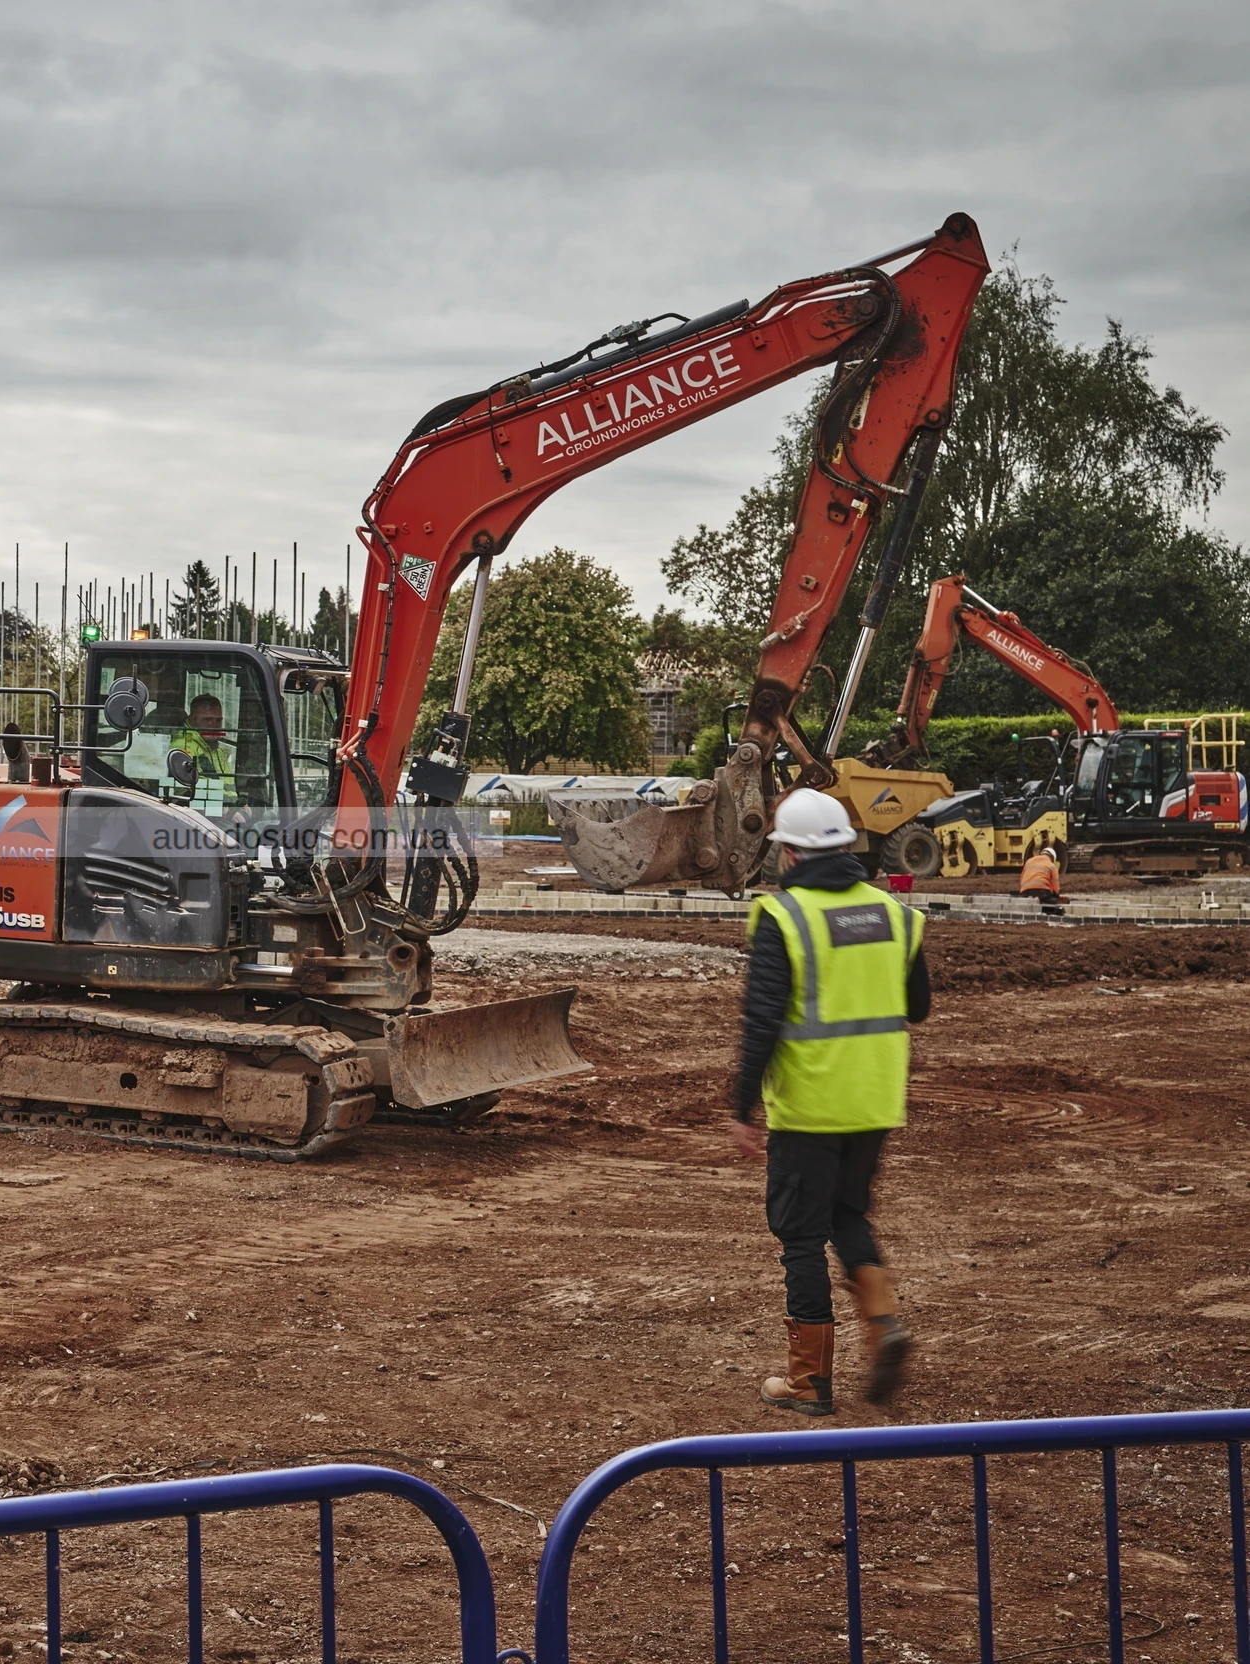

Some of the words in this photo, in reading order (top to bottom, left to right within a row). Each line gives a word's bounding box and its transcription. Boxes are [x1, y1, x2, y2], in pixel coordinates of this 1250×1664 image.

[537, 342, 741, 456] ALLIANCE
[565, 409, 665, 457] GROUNDWORKS
[667, 403, 677, 414] &
[678, 385, 718, 409] CIVILS
[987, 629, 1045, 671] ALLIANCE
